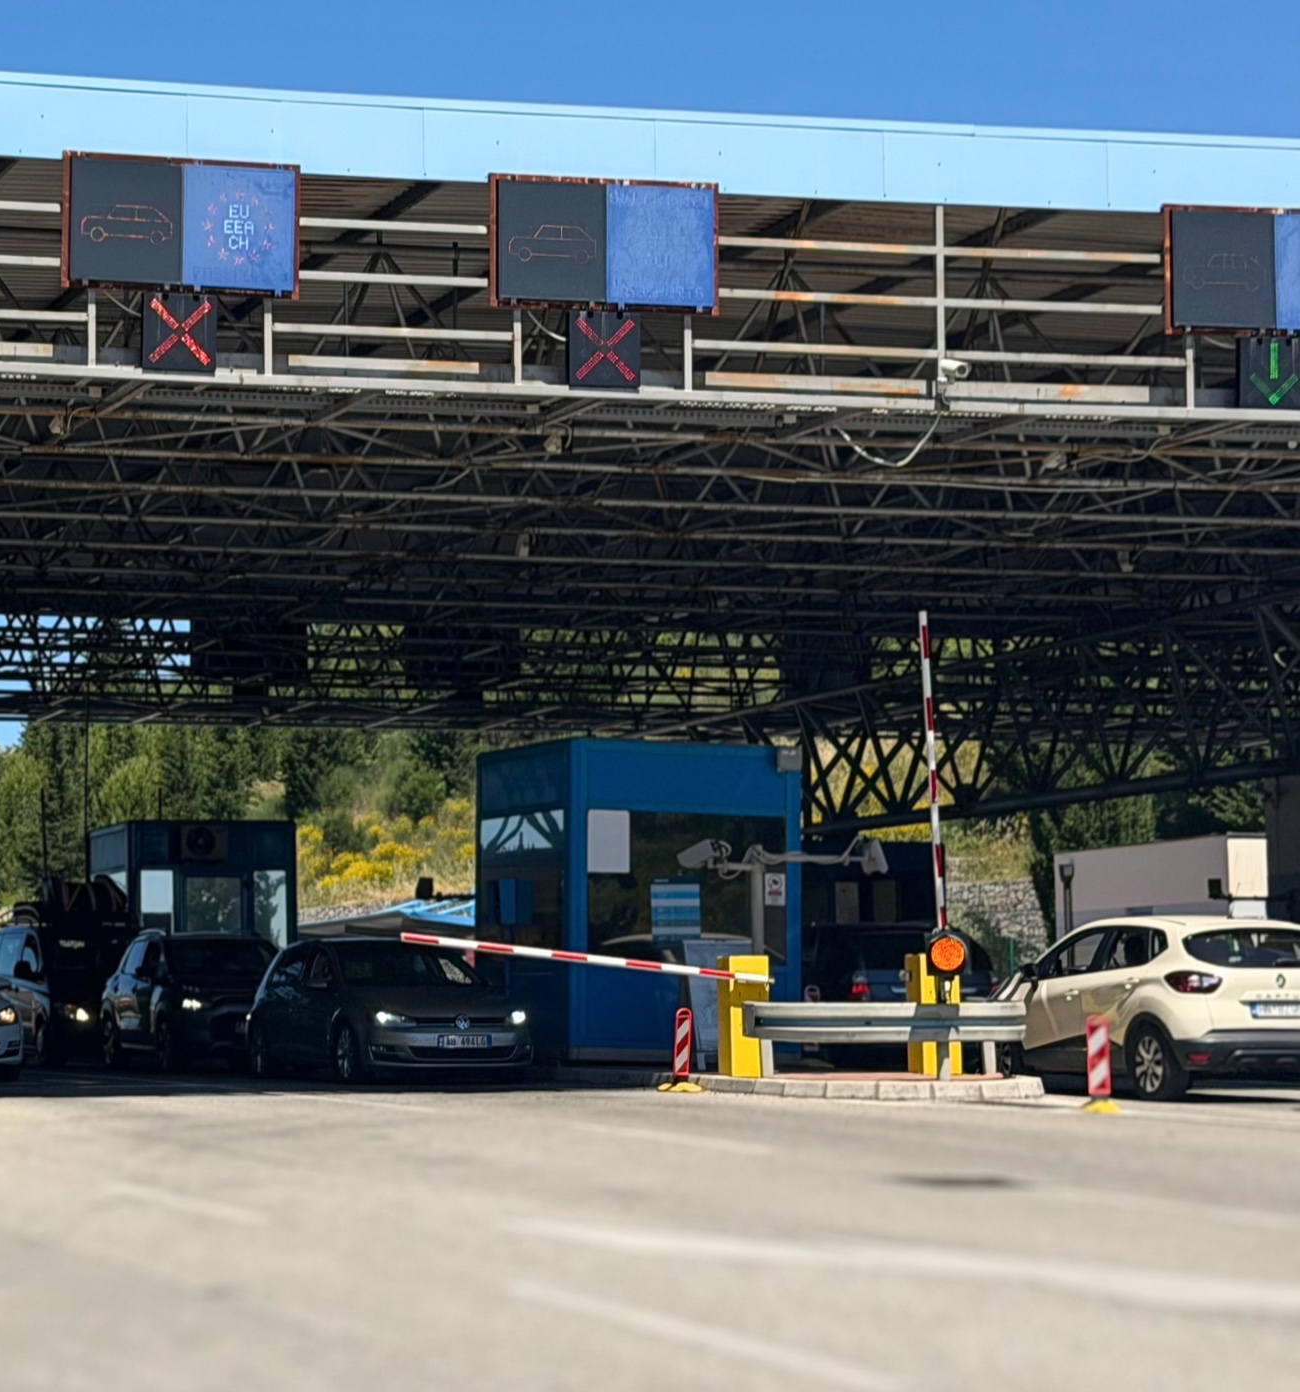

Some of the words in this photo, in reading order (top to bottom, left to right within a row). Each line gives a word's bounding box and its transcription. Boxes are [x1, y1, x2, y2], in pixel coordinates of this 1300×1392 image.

[228, 204, 249, 219] EU
[223, 219, 255, 236] EEA
[228, 235, 249, 251] CH
